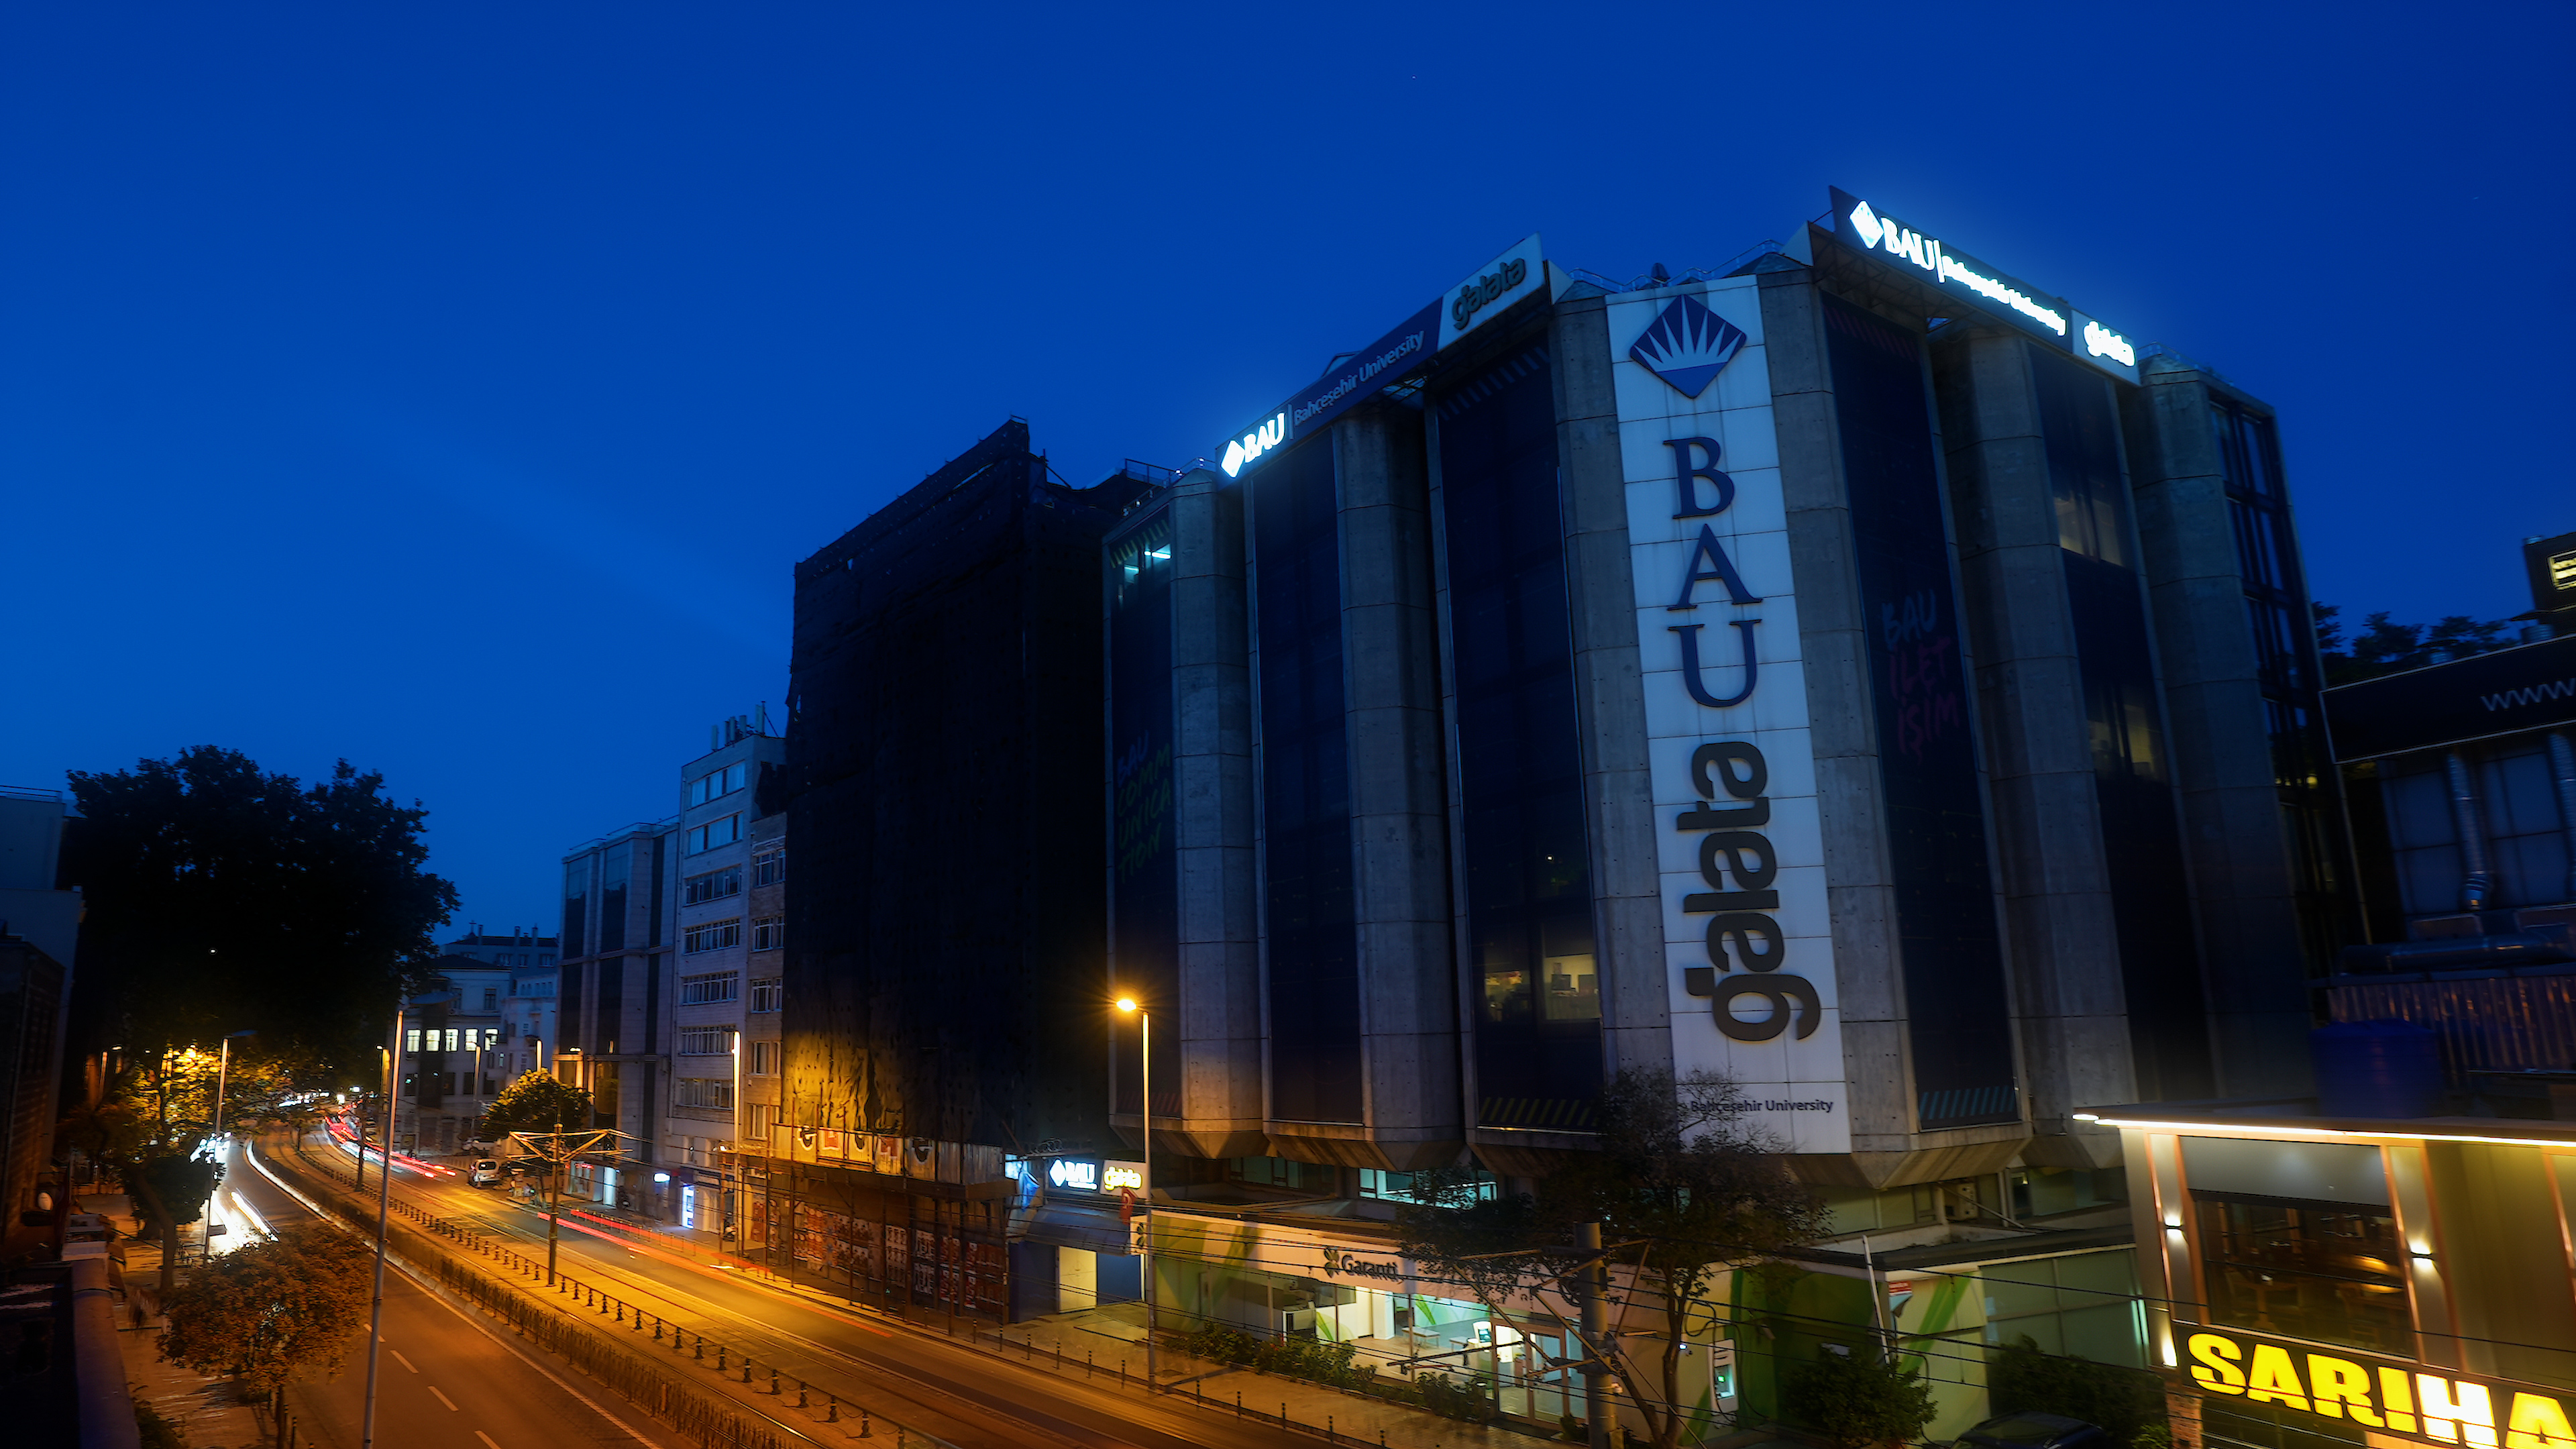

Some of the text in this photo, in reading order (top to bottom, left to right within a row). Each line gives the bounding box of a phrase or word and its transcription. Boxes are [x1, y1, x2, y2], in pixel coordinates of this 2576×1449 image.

[1880, 217, 1935, 271] BAU
[1244, 412, 1286, 464] BAU
[1359, 329, 1425, 383] University
[1663, 437, 1764, 708] BAU
[1881, 588, 1937, 652] BAU
[1766, 1099, 1833, 1113] University
[1342, 1254, 1399, 1282] Garanti
